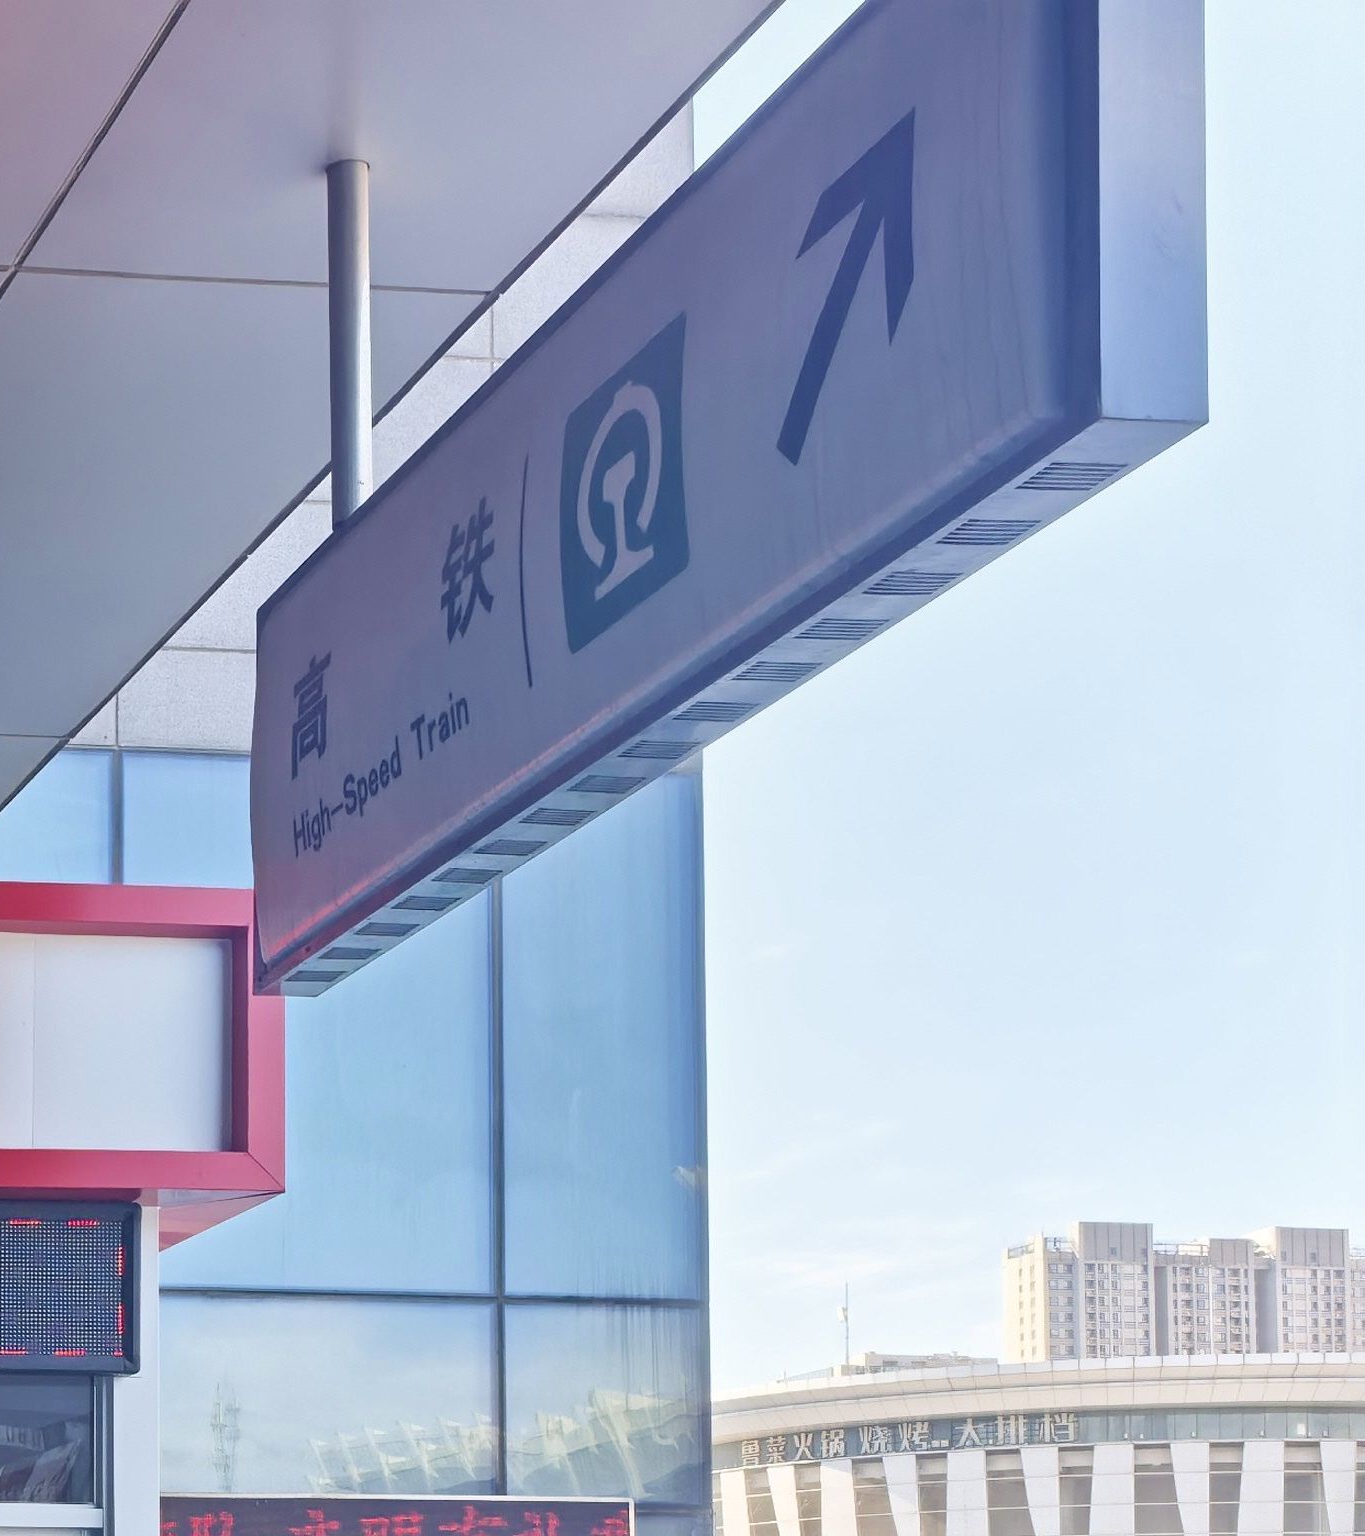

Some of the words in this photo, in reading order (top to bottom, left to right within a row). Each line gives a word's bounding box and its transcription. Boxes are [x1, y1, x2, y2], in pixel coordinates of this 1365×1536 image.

[291, 495, 496, 779] 高铁
[293, 734, 401, 858] High-Speed
[410, 690, 470, 759] Train
